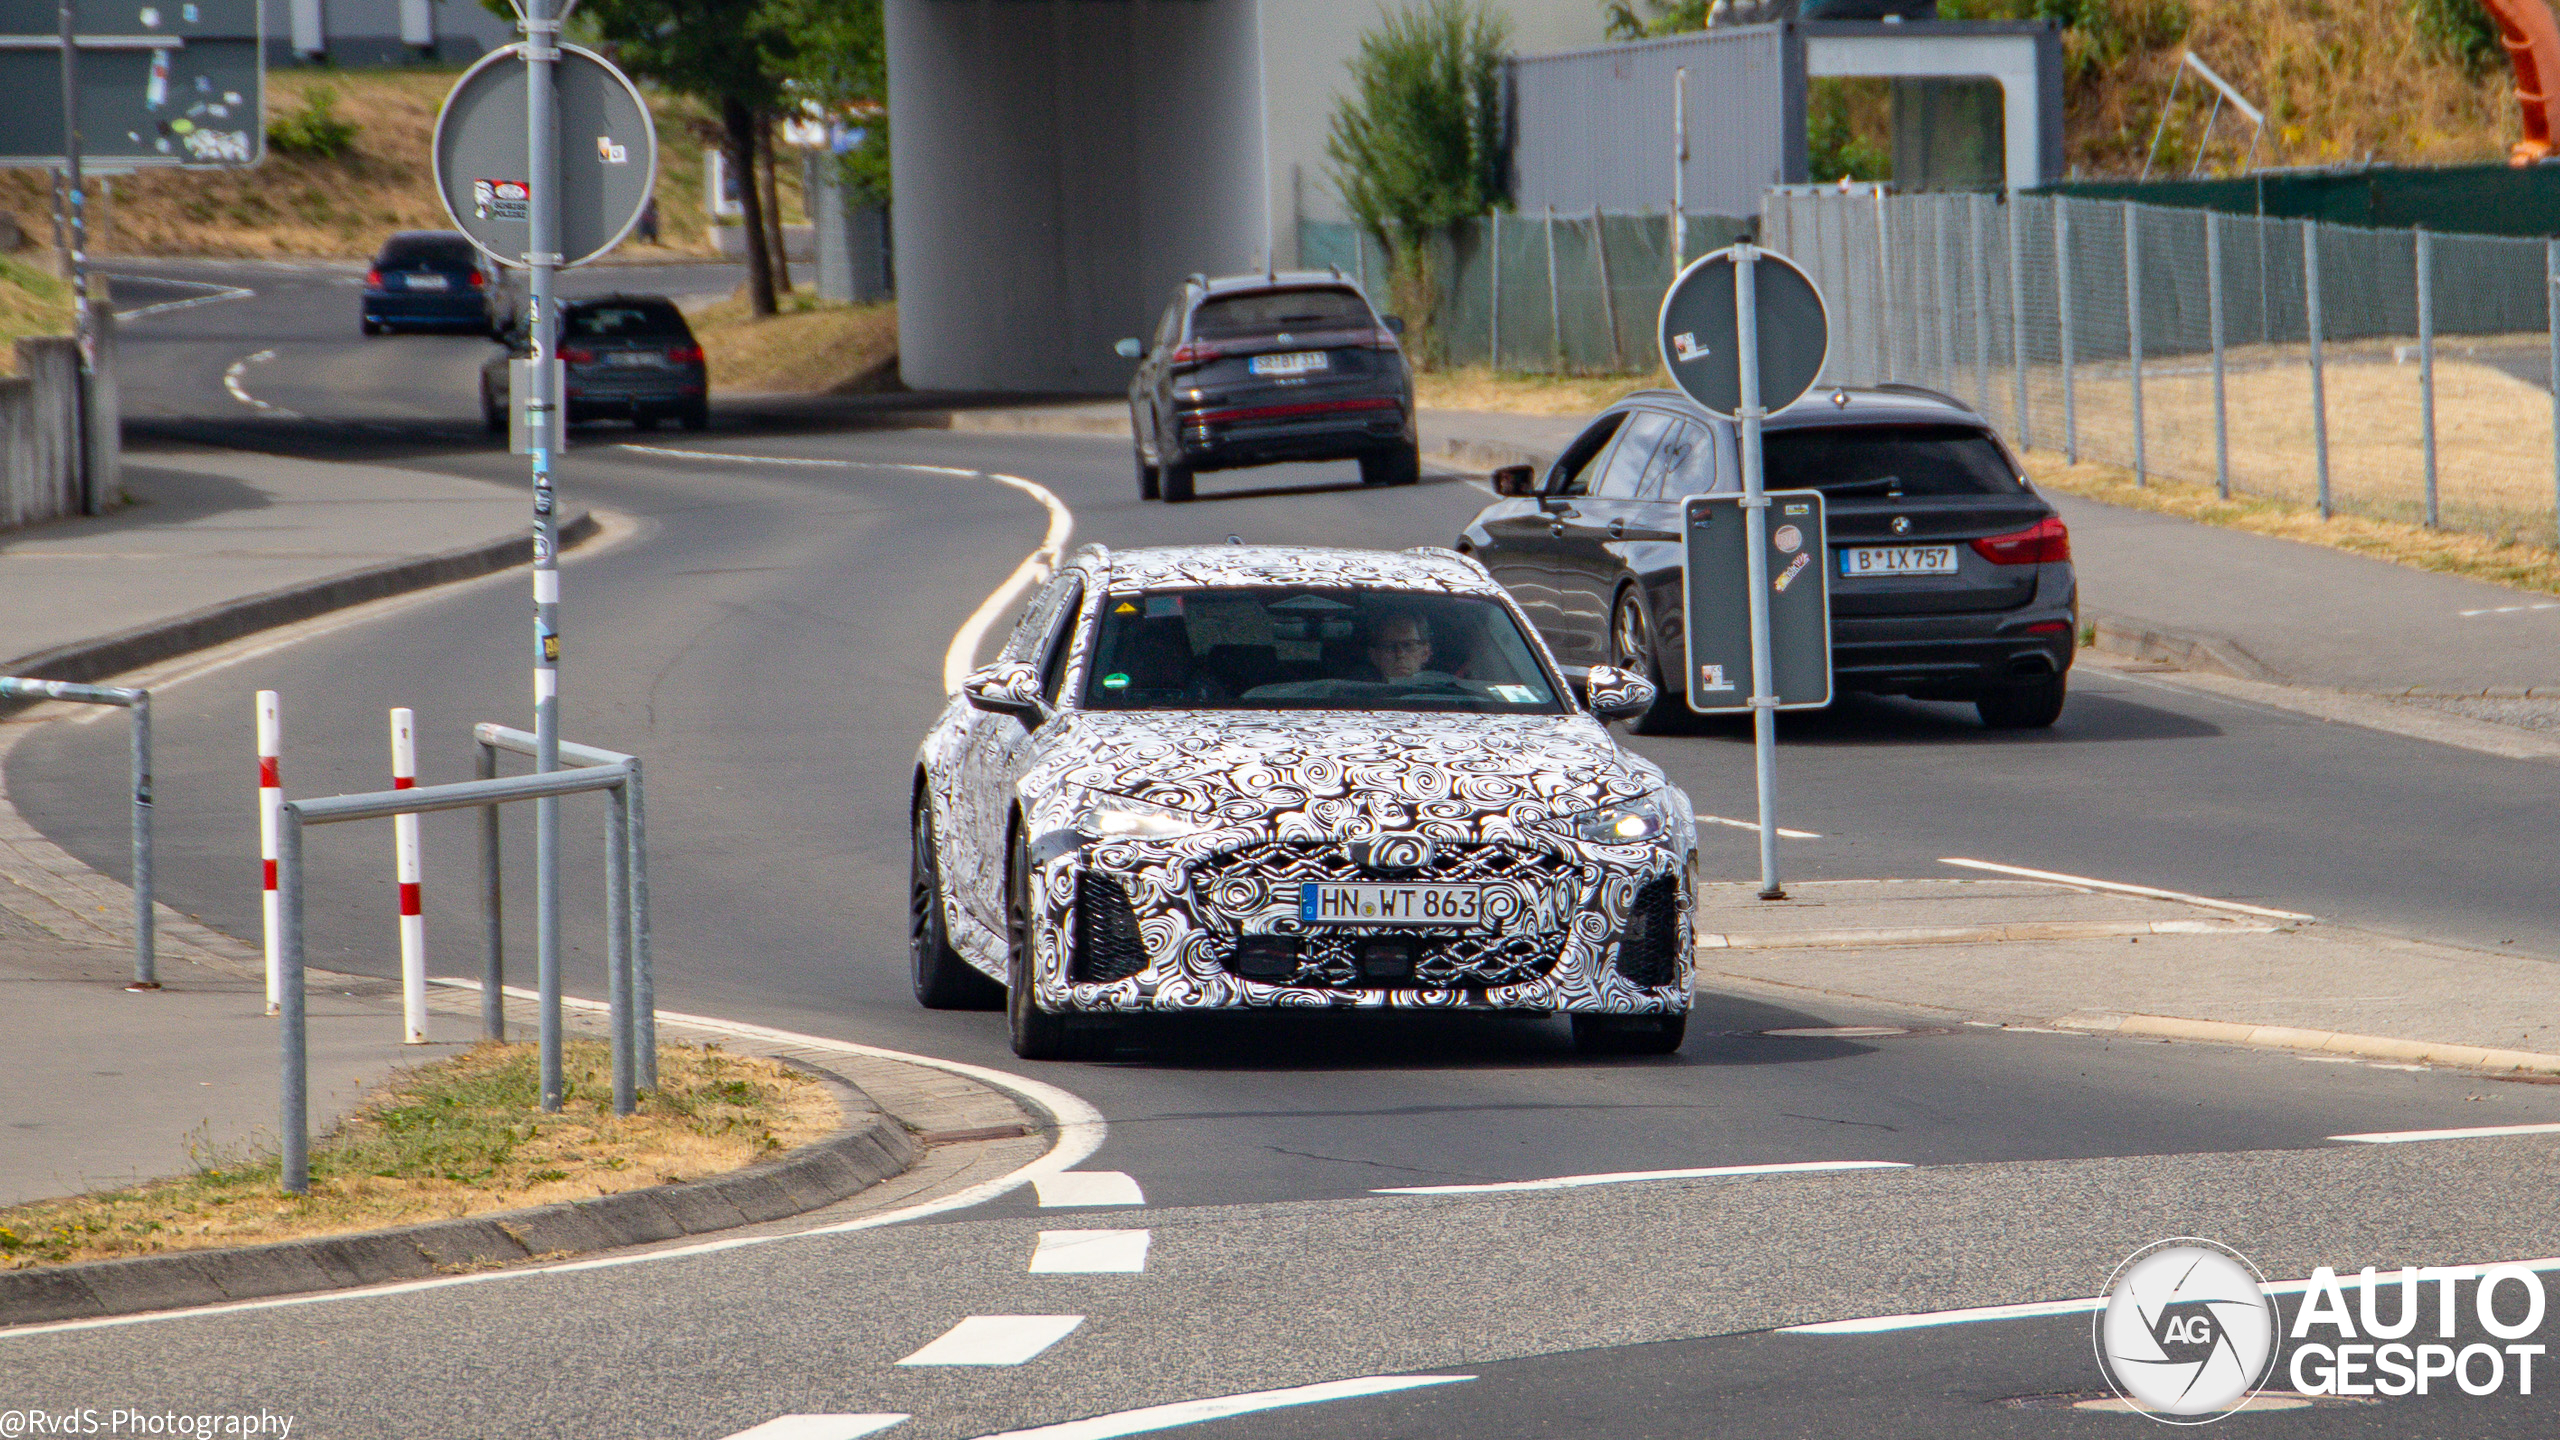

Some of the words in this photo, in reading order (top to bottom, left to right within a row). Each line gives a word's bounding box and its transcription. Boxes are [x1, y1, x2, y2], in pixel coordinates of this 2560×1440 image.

[1859, 551, 1872, 570] B
[1887, 549, 1909, 569] IX
[1913, 548, 1949, 568] 757
[1321, 888, 1359, 916] HN
[1379, 889, 1416, 917] WT
[1423, 889, 1476, 918] 863
